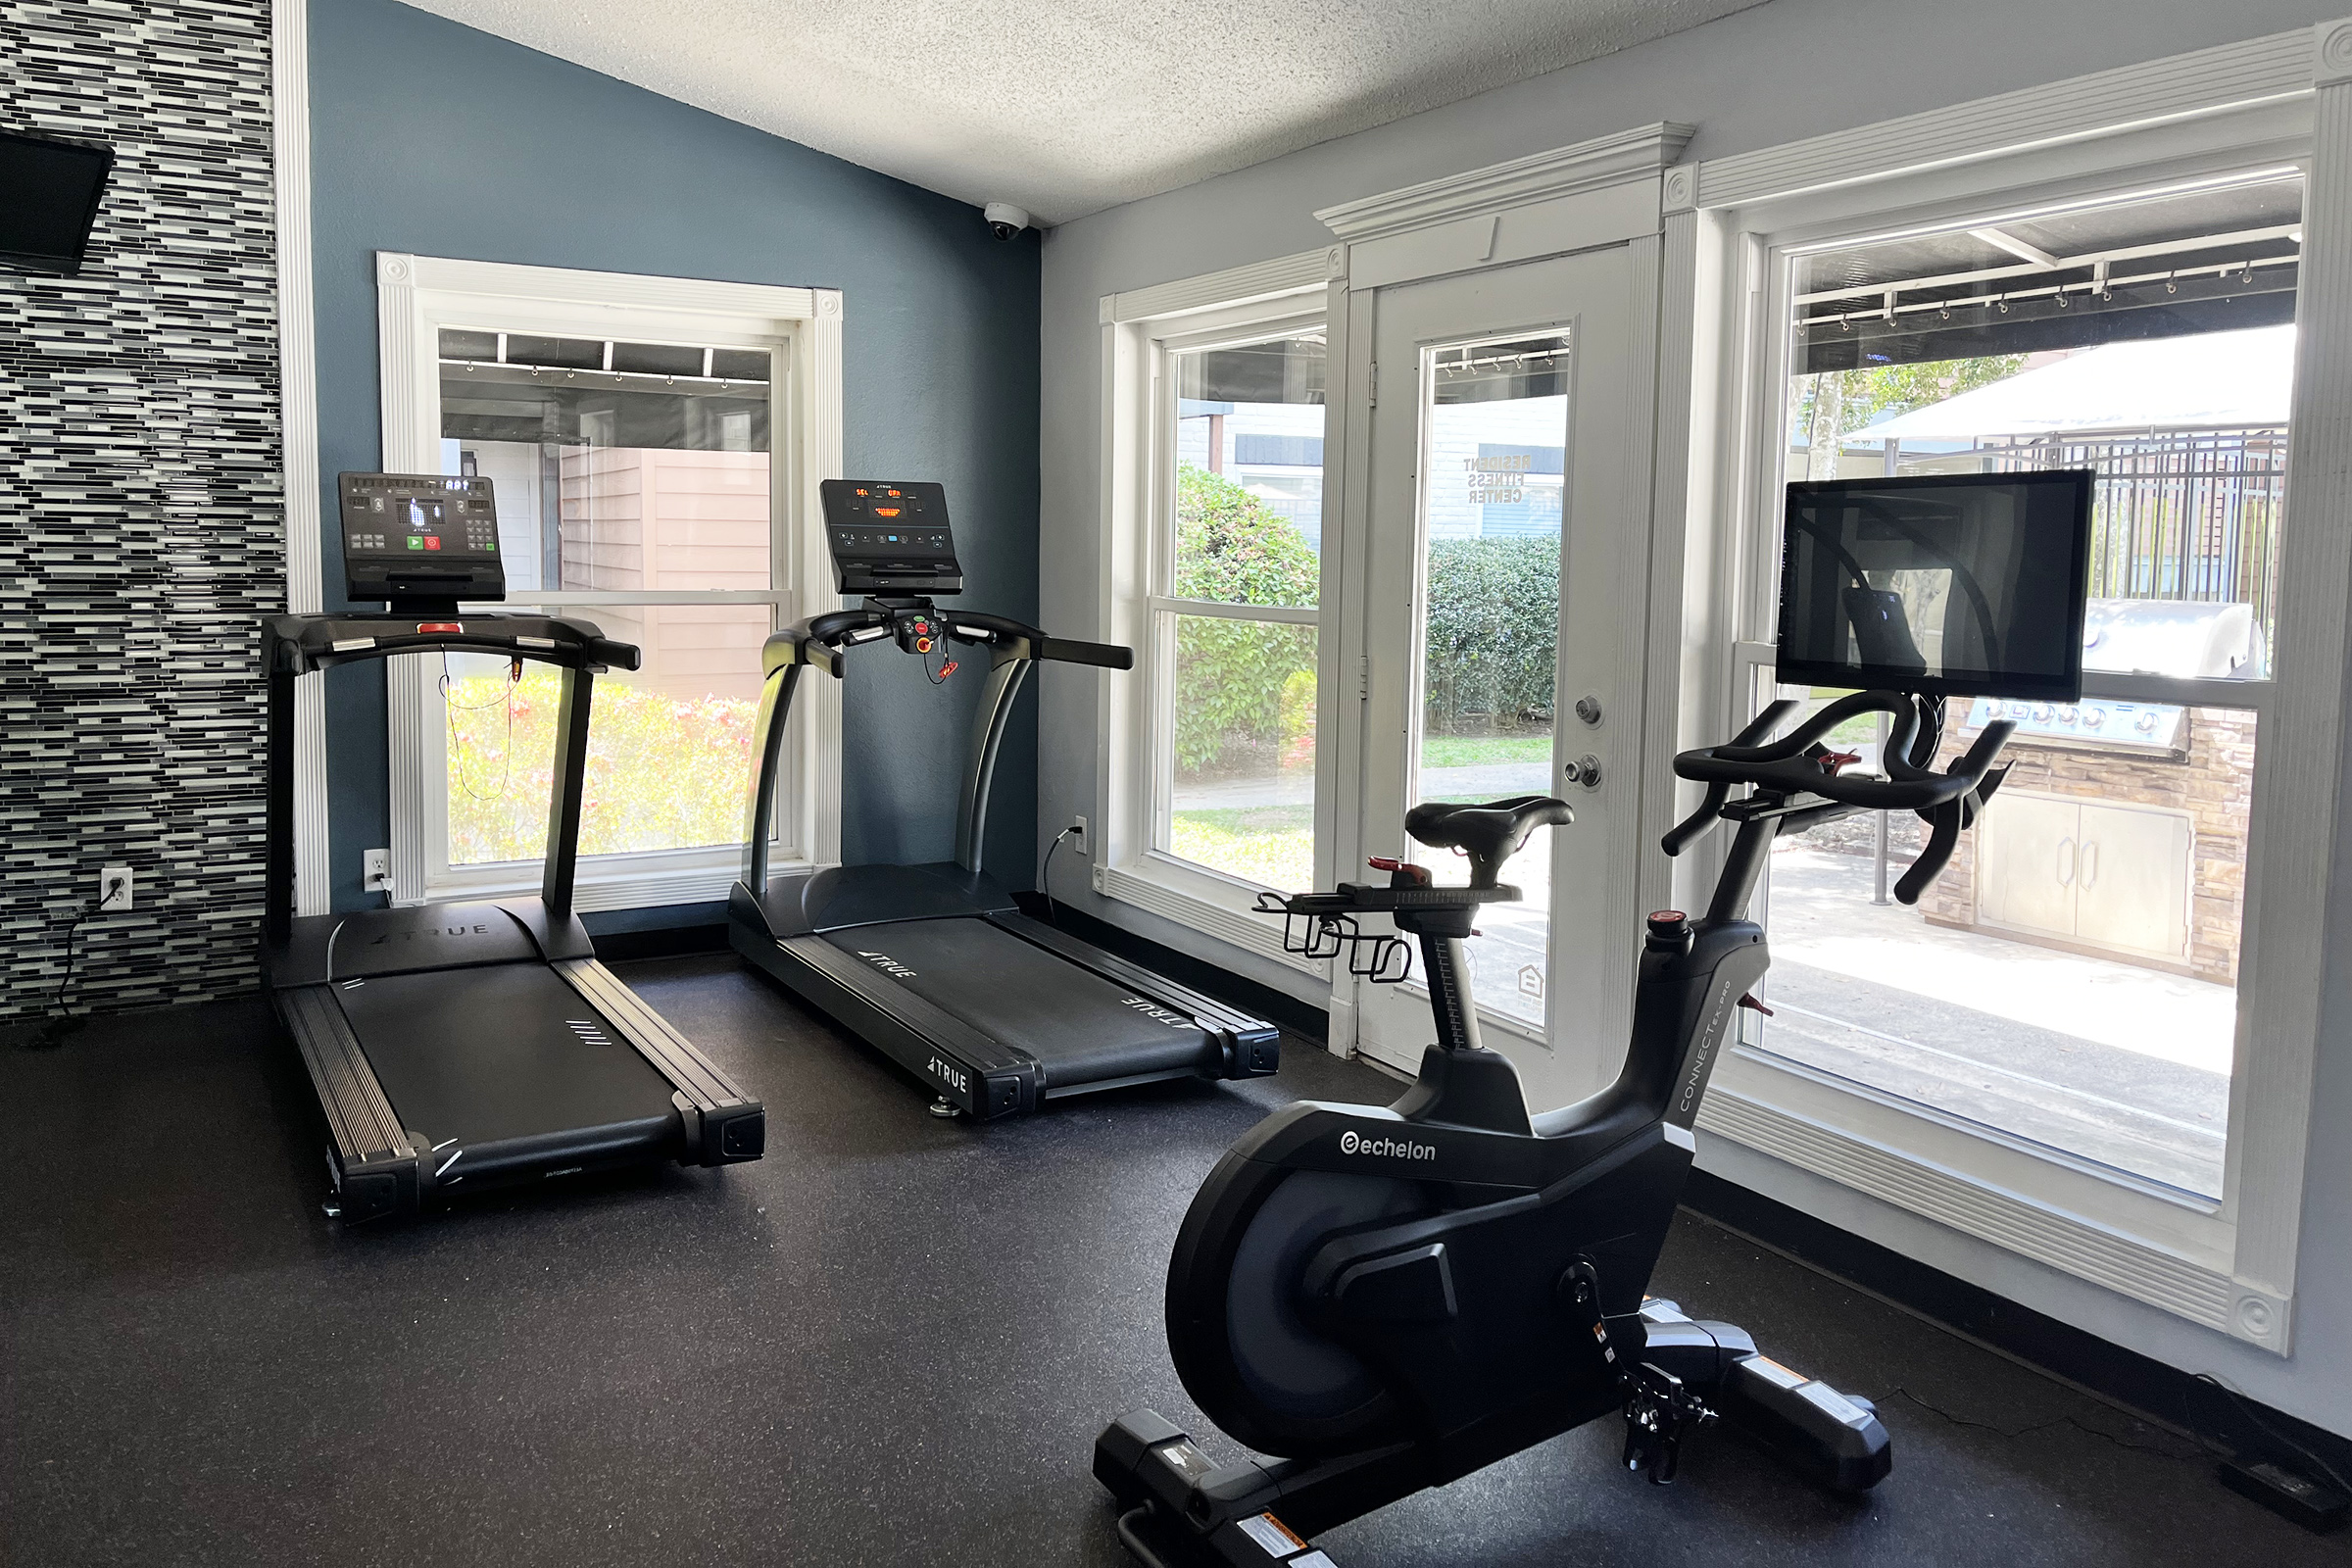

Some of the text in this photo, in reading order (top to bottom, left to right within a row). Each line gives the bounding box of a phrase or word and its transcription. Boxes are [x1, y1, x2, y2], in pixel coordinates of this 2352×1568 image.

[870, 956, 917, 978] TRUE
[1120, 997, 1181, 1025] TRUE
[936, 1058, 966, 1094] TRUE
[1680, 1023, 1714, 1112] CONNECT
[1359, 1137, 1436, 1161] echelon
